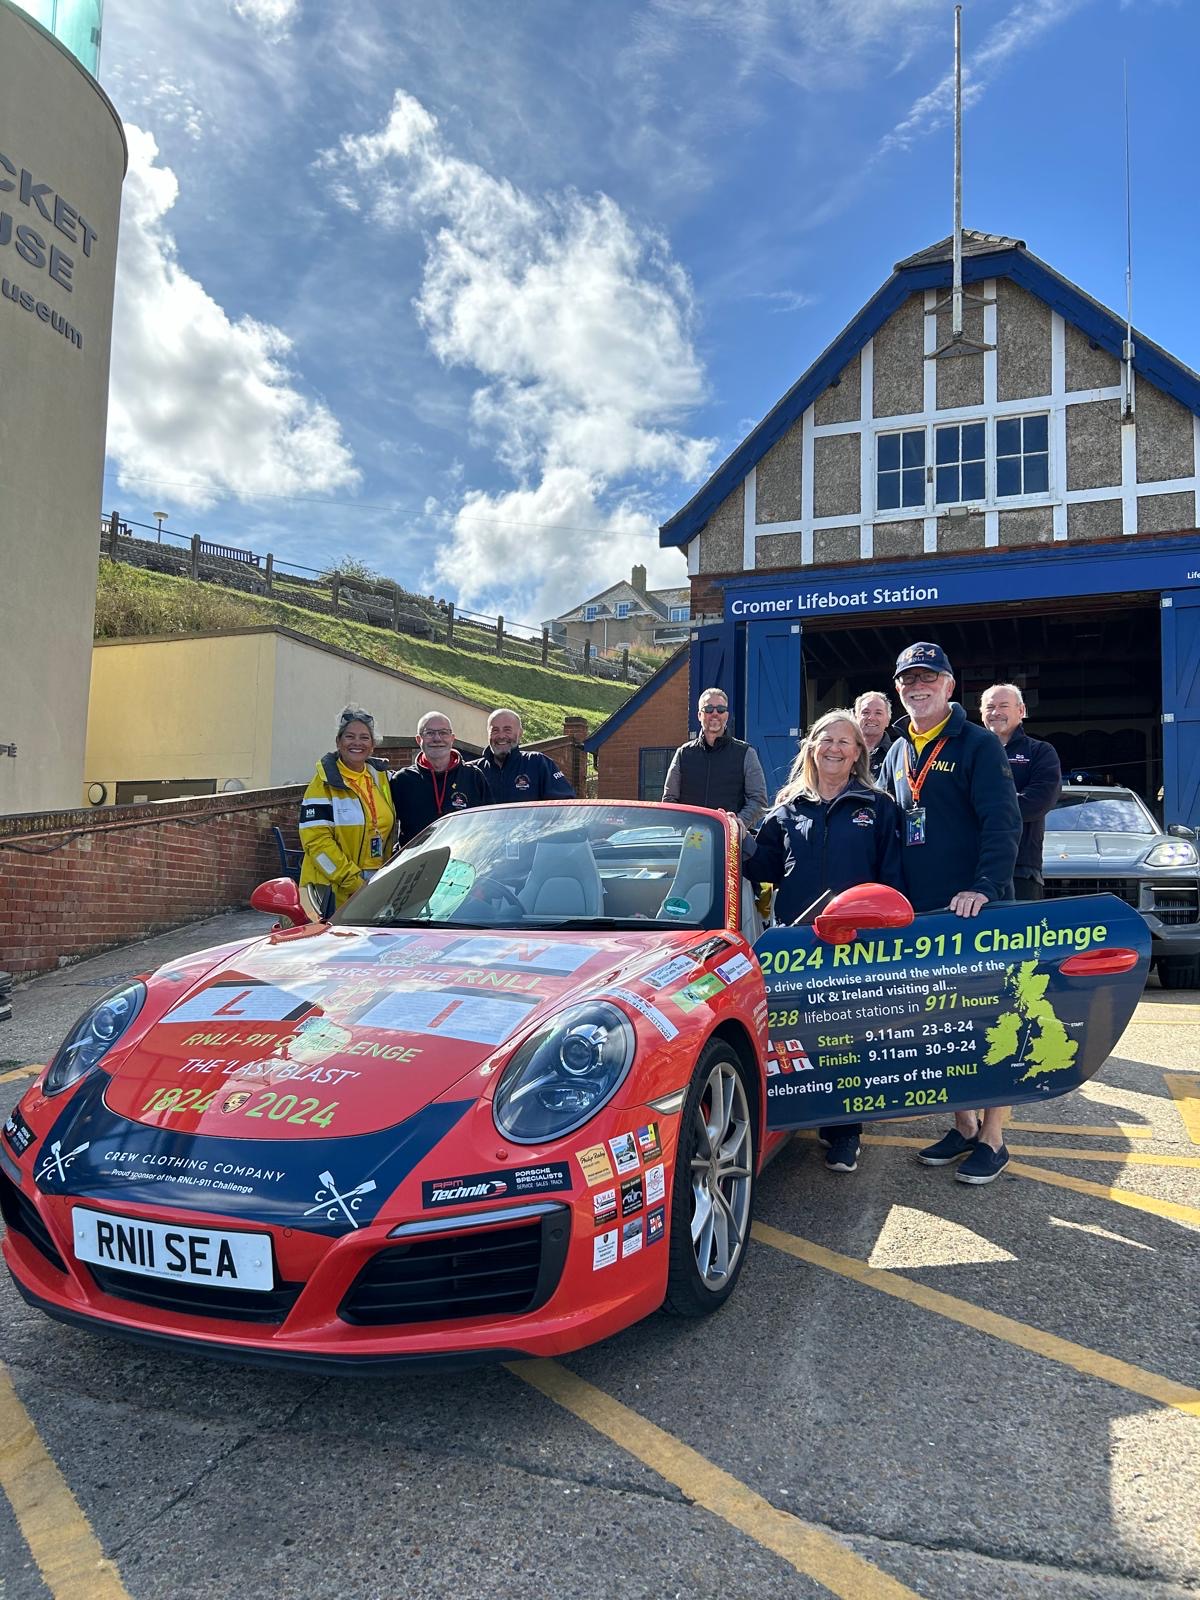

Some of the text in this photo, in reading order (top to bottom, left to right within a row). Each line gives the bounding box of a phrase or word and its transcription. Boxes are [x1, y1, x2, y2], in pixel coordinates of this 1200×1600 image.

[731, 585, 938, 615] Cromer Lifeboat Station
[930, 760, 956, 773] RNLI
[759, 946, 824, 975] 2024
[833, 932, 963, 967] RNLI-911
[974, 924, 1108, 950] Challenge
[409, 970, 453, 981] THE
[455, 970, 542, 990] RNLI
[764, 960, 1005, 994] o drive clockwise around the whole of the
[807, 993, 825, 1005] UK
[828, 990, 840, 1002] &
[842, 985, 884, 1001] Ireland
[886, 981, 929, 999] visiting
[768, 1010, 799, 1028] 238
[804, 1007, 853, 1024] lifeboat
[856, 1003, 905, 1019] stations
[908, 1001, 920, 1013] in
[924, 992, 958, 1012] 911
[962, 993, 999, 1008] hours
[817, 1020, 974, 1047] Start: 9.11am 23-8-24
[180, 1033, 424, 1063] RNLI-911 CHALLENGE
[818, 1040, 977, 1067] Finish: 9.11am 30-9-24
[178, 1058, 226, 1073] THE
[767, 1063, 978, 1097] elebrating 200 years of the RNLI
[142, 1087, 340, 1128] 1824 2024
[843, 1095, 886, 1113] 1824
[904, 1088, 949, 1107] 2024
[104, 1151, 286, 1182] CREW CLOTHING COMPANY
[515, 1167, 551, 1178] PORSCHE
[516, 1172, 563, 1184] SPECIALISTS
[111, 1168, 254, 1194] Proud sponsor of the RNLI-911 Challenge
[431, 1183, 491, 1202] Technik
[96, 1219, 239, 1279] RN11 SEA
